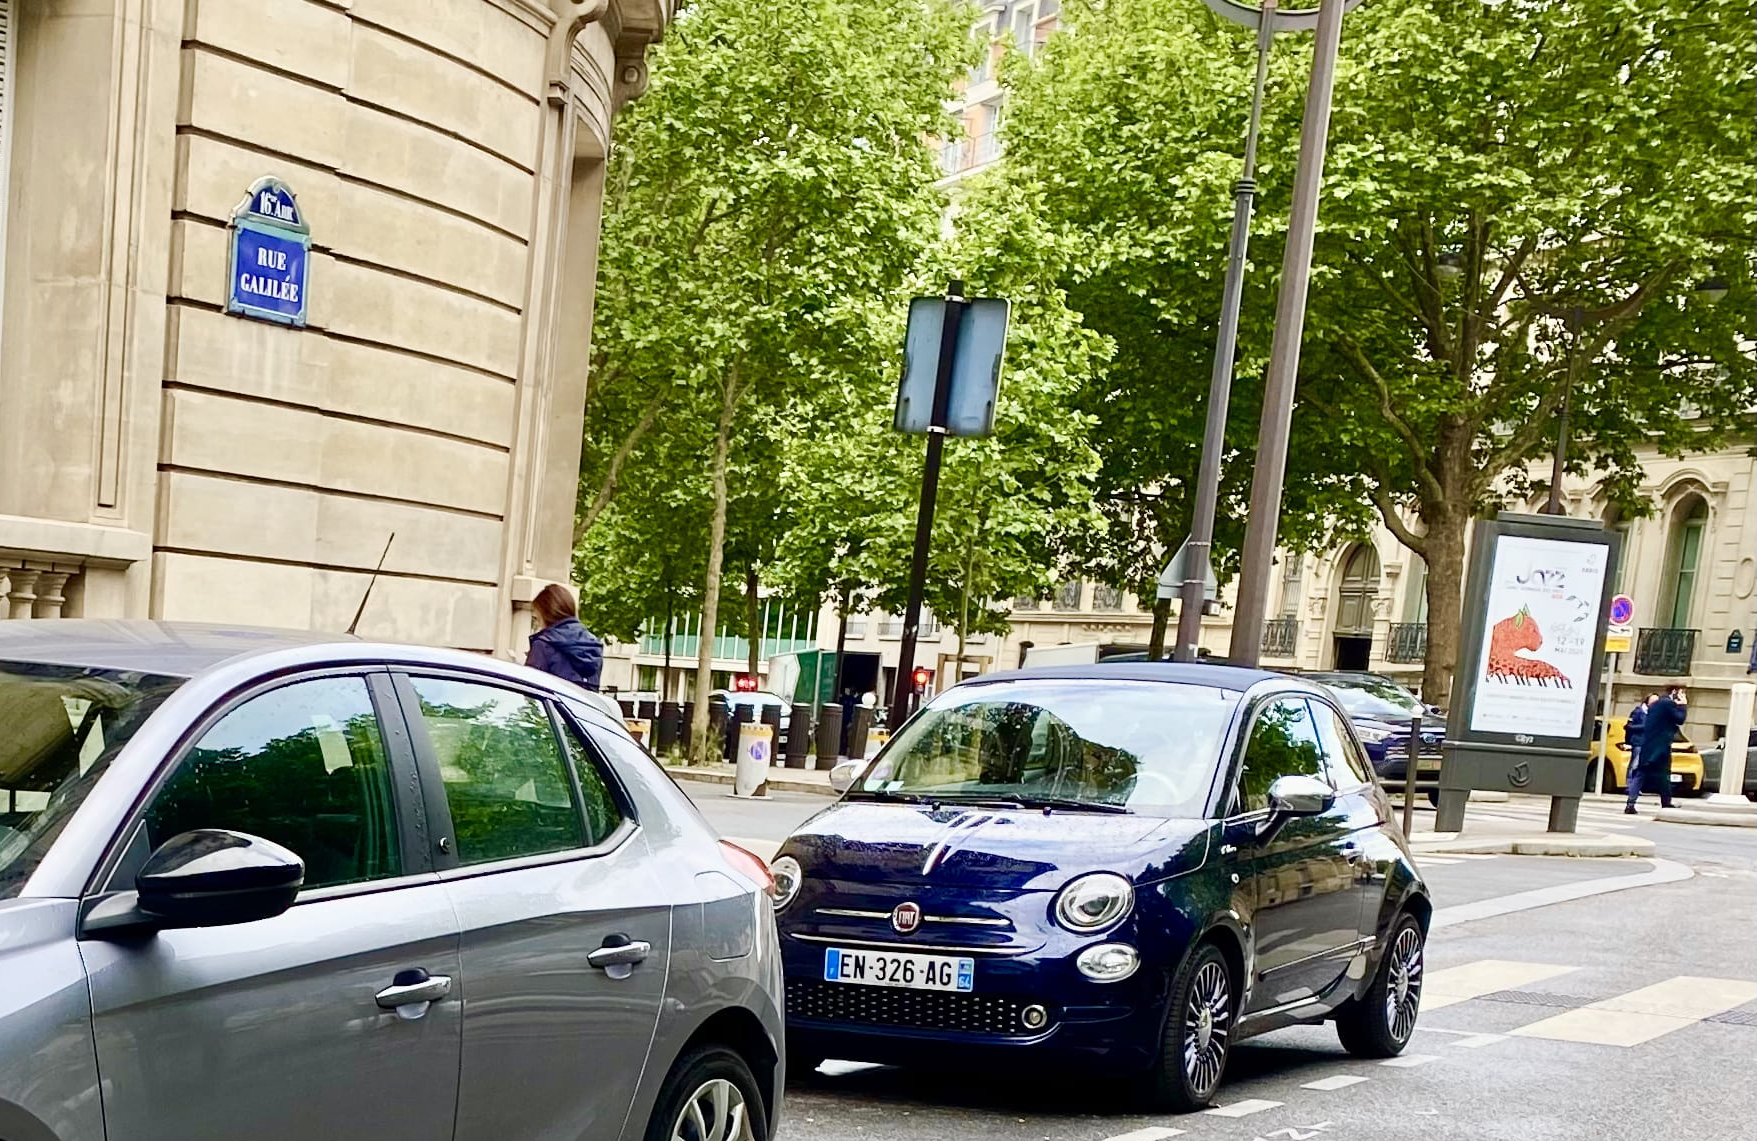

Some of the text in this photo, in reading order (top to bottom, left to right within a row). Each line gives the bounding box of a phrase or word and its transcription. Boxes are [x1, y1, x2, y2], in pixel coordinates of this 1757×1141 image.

[257, 247, 286, 271] RUE
[241, 274, 299, 302] GALILÉE
[898, 911, 916, 925] FIAT
[840, 953, 952, 986] EN-326-AG
